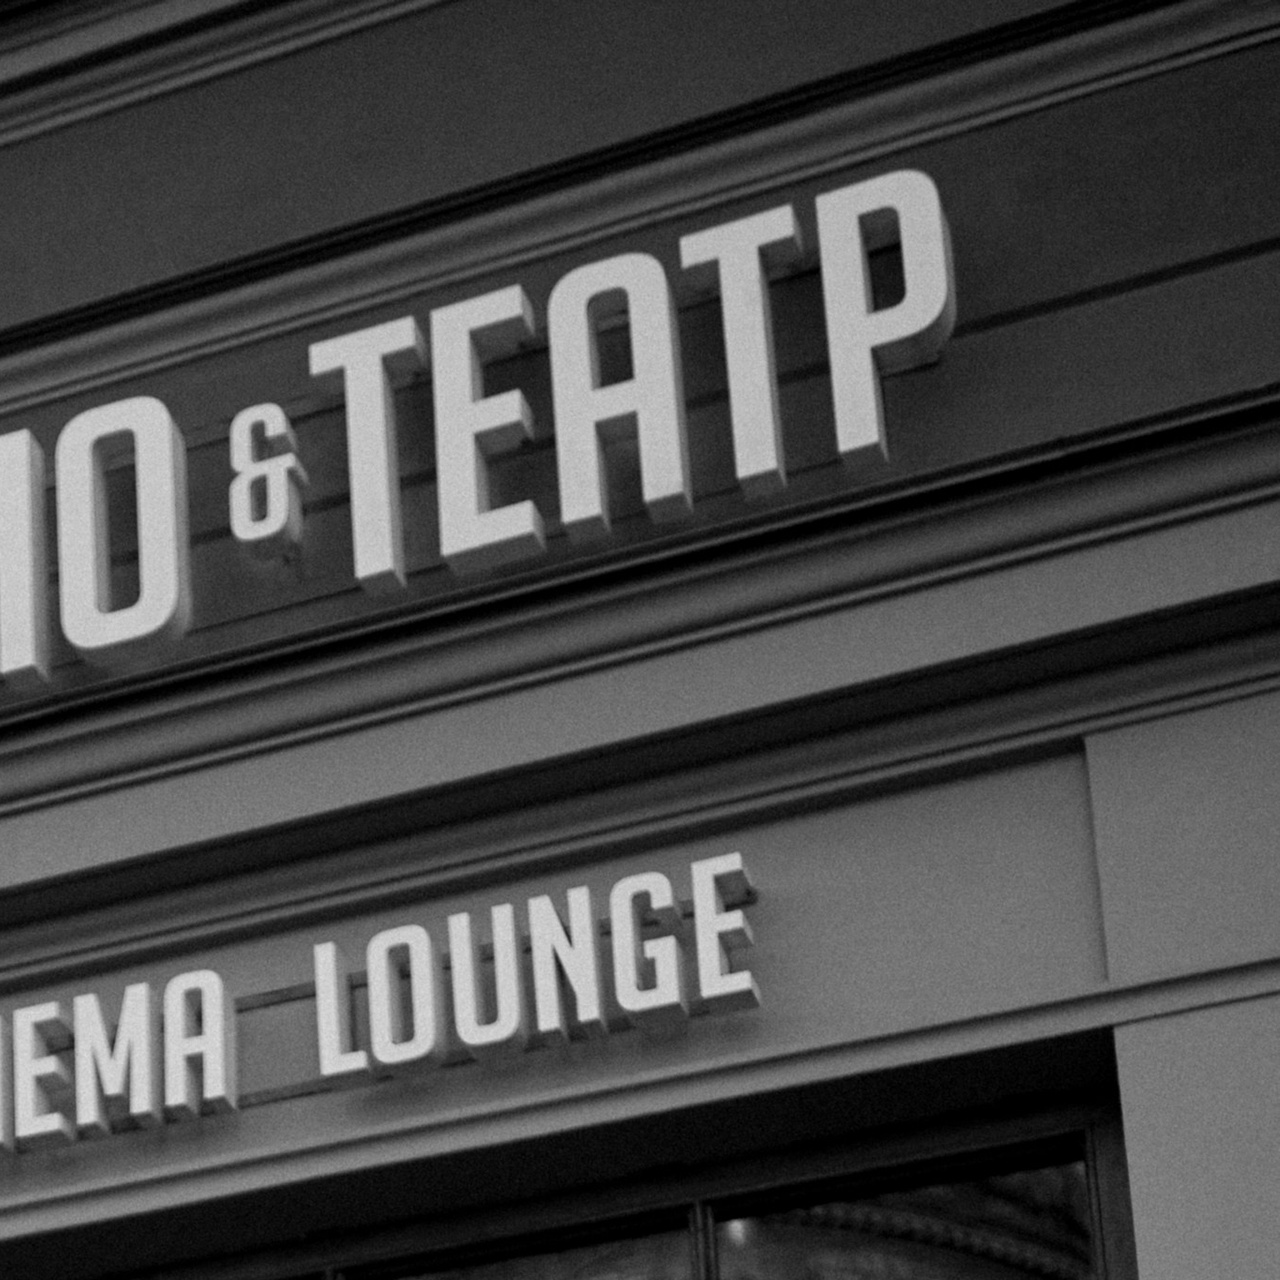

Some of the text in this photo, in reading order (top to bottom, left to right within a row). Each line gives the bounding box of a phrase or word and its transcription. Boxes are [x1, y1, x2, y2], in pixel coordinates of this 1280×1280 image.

[230, 403, 300, 542] &
[309, 171, 950, 581] ТЕАТР
[312, 851, 757, 1077] LOUNGE
